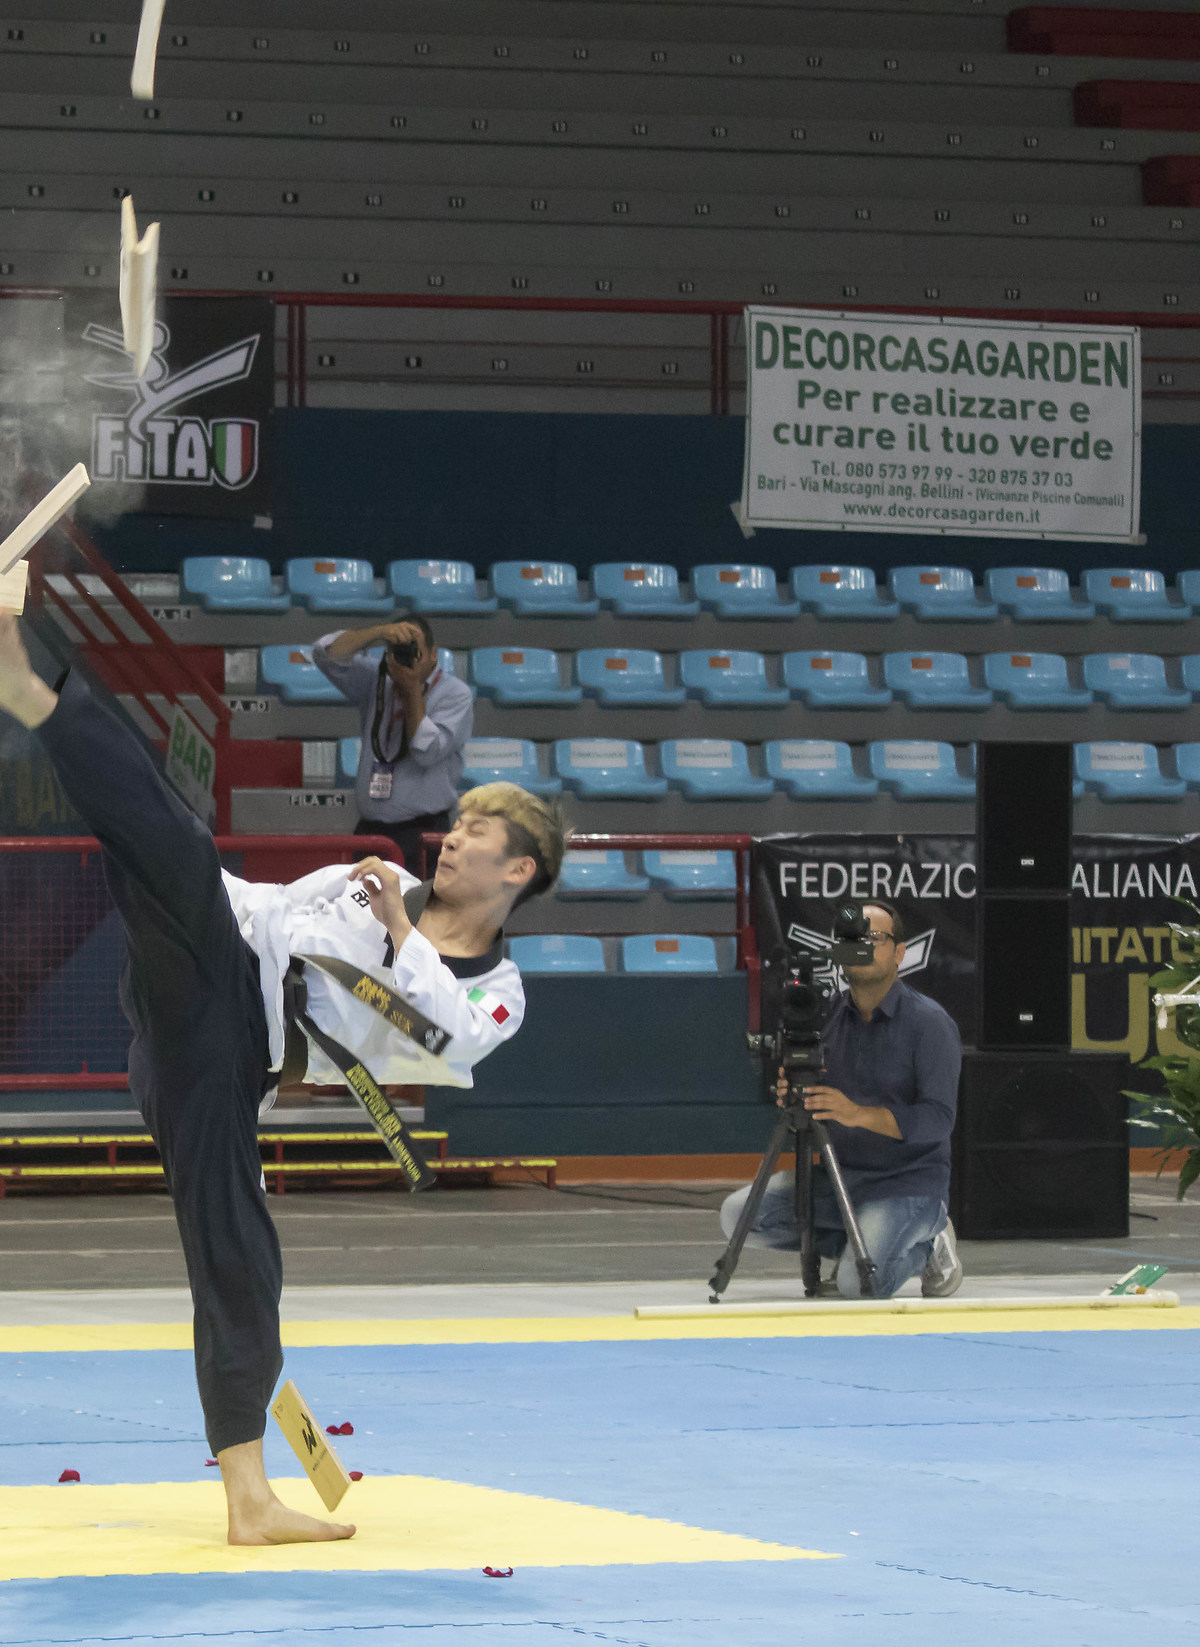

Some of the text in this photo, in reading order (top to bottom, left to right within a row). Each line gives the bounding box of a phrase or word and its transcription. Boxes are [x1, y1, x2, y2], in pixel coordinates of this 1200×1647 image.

[755, 321, 1129, 388] DECORCASAGARDEN
[797, 379, 1090, 423] Per realizzare e
[773, 422, 1113, 461] curare il tuo verde
[757, 475, 786, 491] Bari
[800, 477, 819, 493] Via
[823, 479, 885, 499] Mascagni
[888, 483, 917, 501] ang.
[921, 482, 964, 500] Bellini
[1032, 491, 1071, 505] Piscine
[812, 459, 841, 477] Tel.
[845, 462, 874, 478] 080
[878, 463, 907, 480] 573
[912, 465, 930, 481] 97
[934, 466, 953, 482] 99
[968, 468, 996, 484] 320
[1000, 470, 1027, 486] 875
[1032, 471, 1049, 487] 37
[1054, 472, 1073, 487] 03
[843, 501, 1041, 525] www.decorcasagarden.it
[172, 714, 212, 791] BAR
[779, 862, 1199, 899] FEDERAZIO ALIANA
